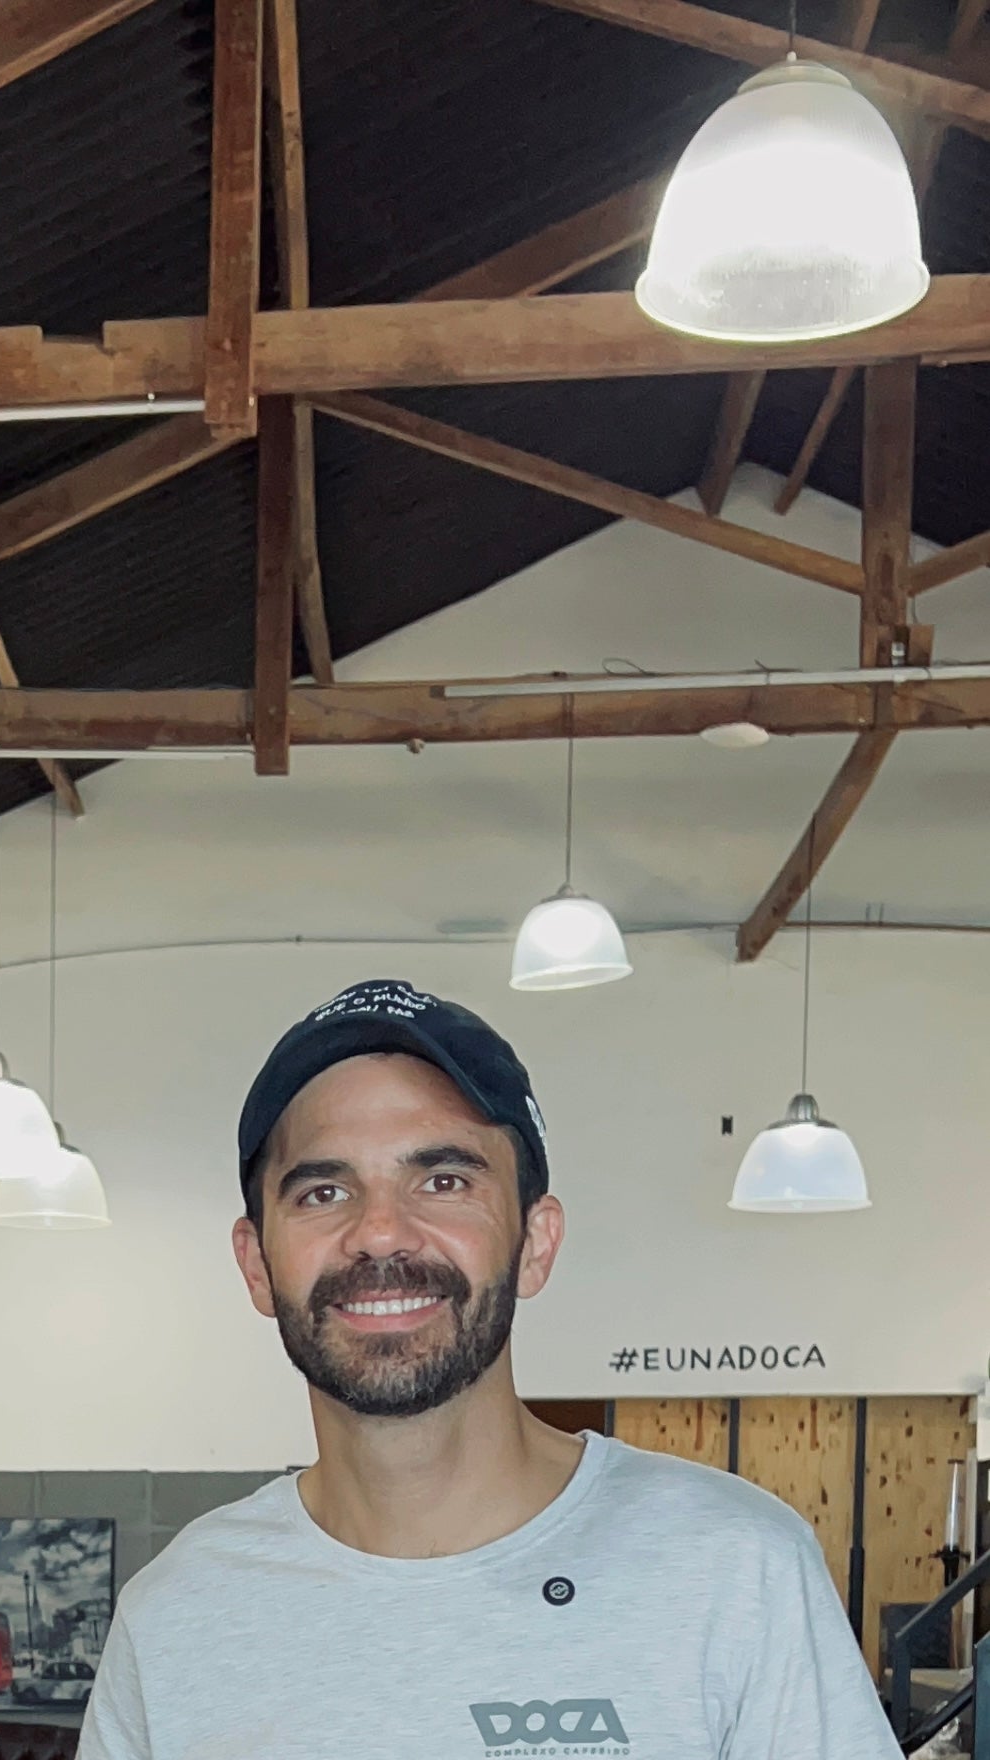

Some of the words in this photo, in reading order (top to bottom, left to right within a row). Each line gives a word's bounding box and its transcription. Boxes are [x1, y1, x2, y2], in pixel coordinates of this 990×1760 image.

[609, 1344, 826, 1373] #EUNADOCA
[469, 1698, 630, 1747] DOCA
[485, 1747, 557, 1758] COMPLEXO
